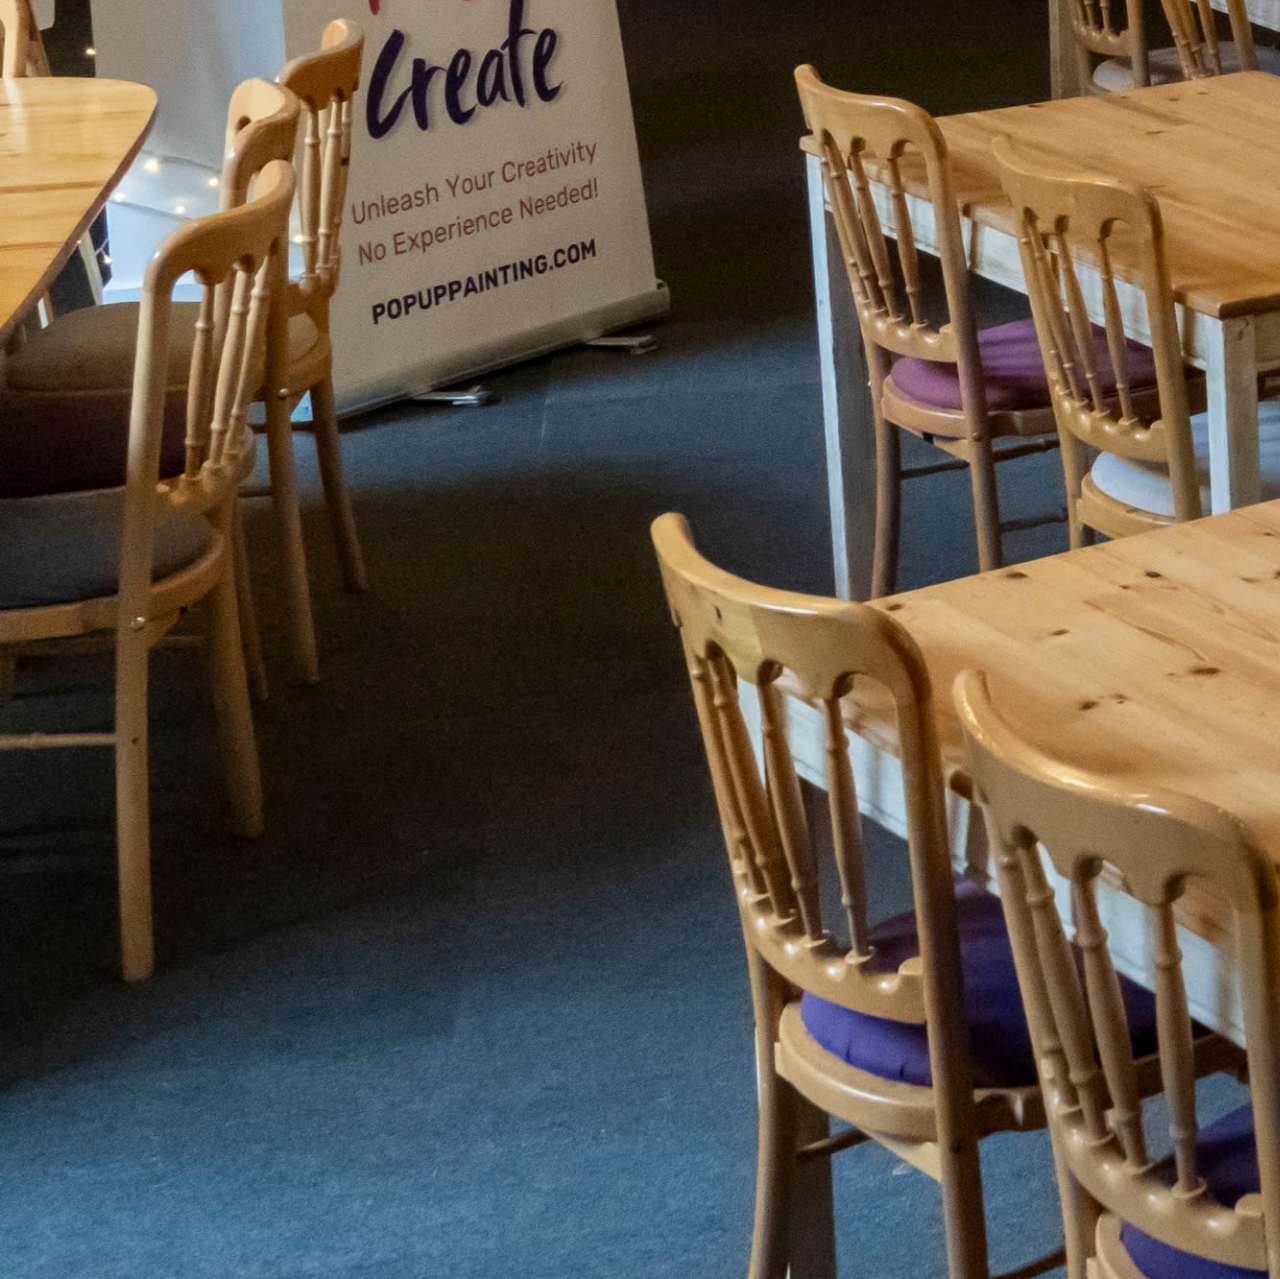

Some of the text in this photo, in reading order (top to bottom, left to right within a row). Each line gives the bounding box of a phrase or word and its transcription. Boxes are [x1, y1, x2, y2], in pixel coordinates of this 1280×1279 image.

[352, 140, 598, 225] Unleash Your Creativity
[358, 176, 599, 266] No Experience Needed!
[371, 238, 597, 325] POPUPPAINTING.COM
